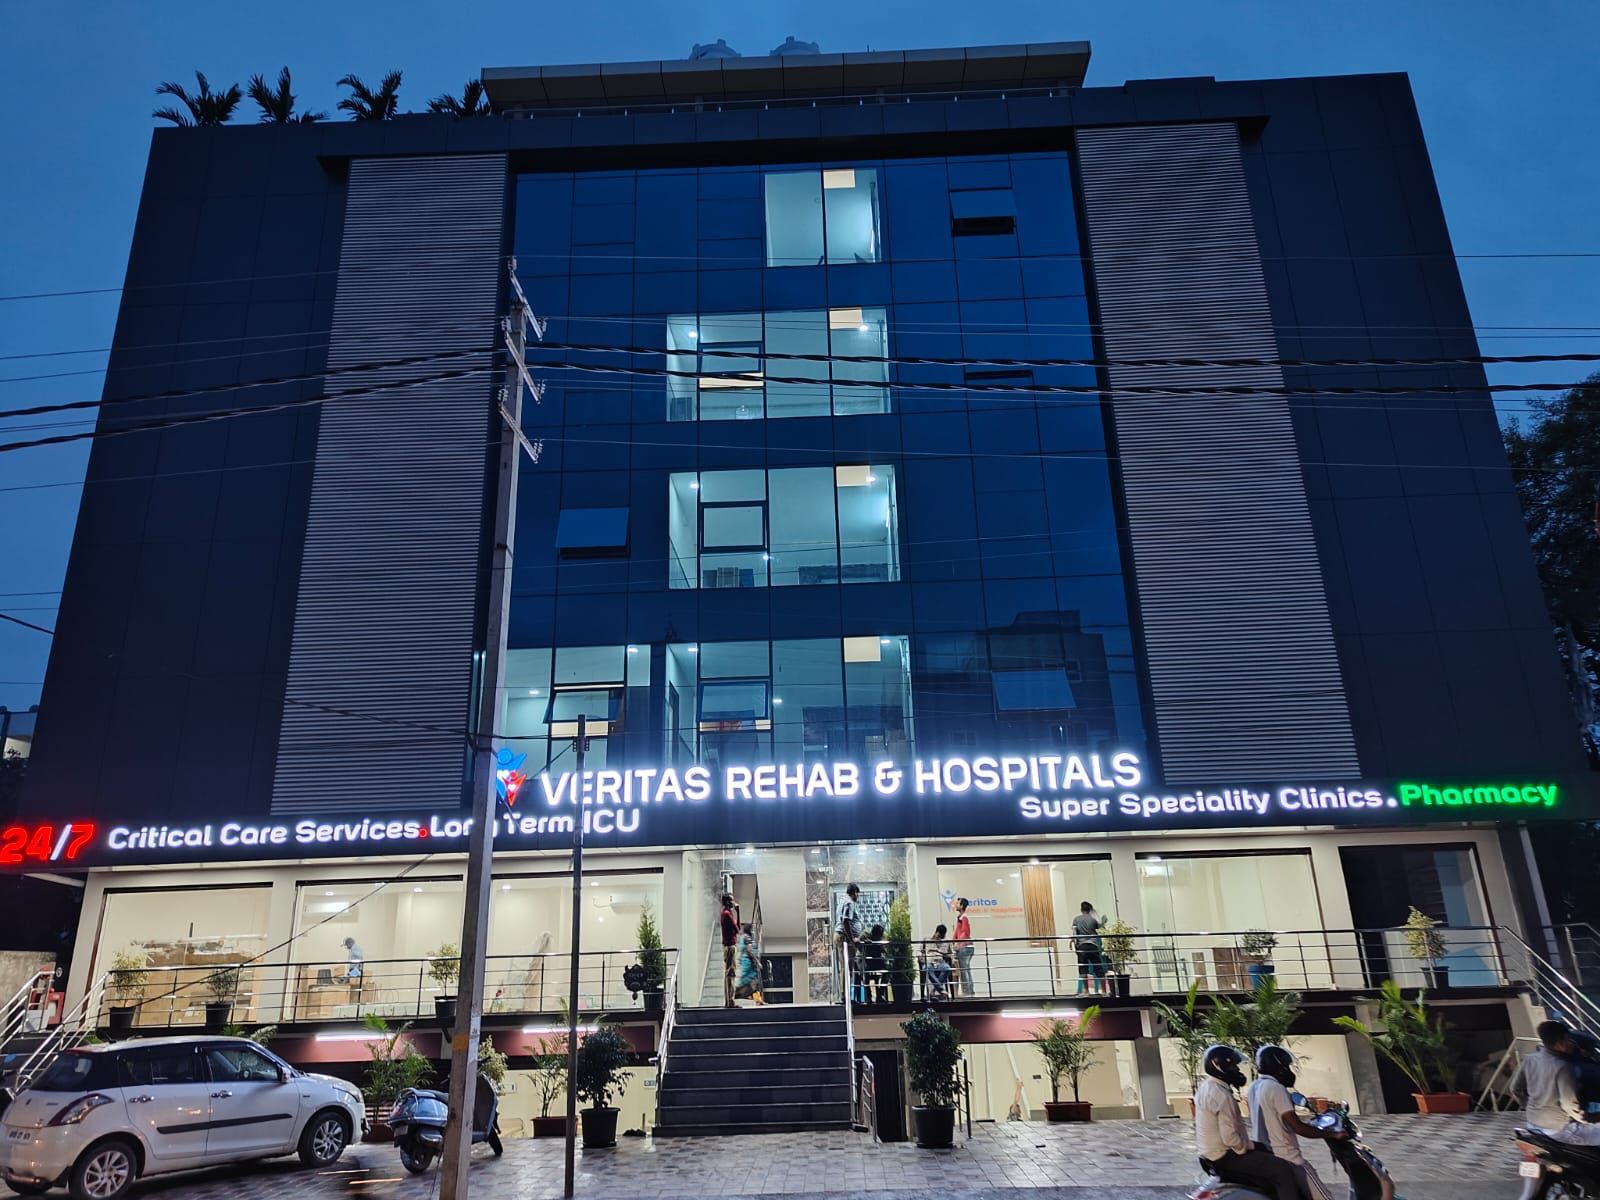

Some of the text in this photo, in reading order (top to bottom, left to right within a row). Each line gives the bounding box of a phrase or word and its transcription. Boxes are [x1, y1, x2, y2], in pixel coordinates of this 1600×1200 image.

[540, 752, 1142, 808] VERITAS REHAB & HOSPITALS
[1019, 796, 1110, 821] Super
[1119, 789, 1271, 818] Speciality
[1399, 783, 1558, 807] Pharmacy
[0, 822, 95, 863] 24/7
[107, 823, 212, 850] Critical
[220, 823, 289, 846] Care
[503, 812, 575, 836] Term
[582, 807, 641, 835] ICU
[967, 898, 998, 907] eritas
